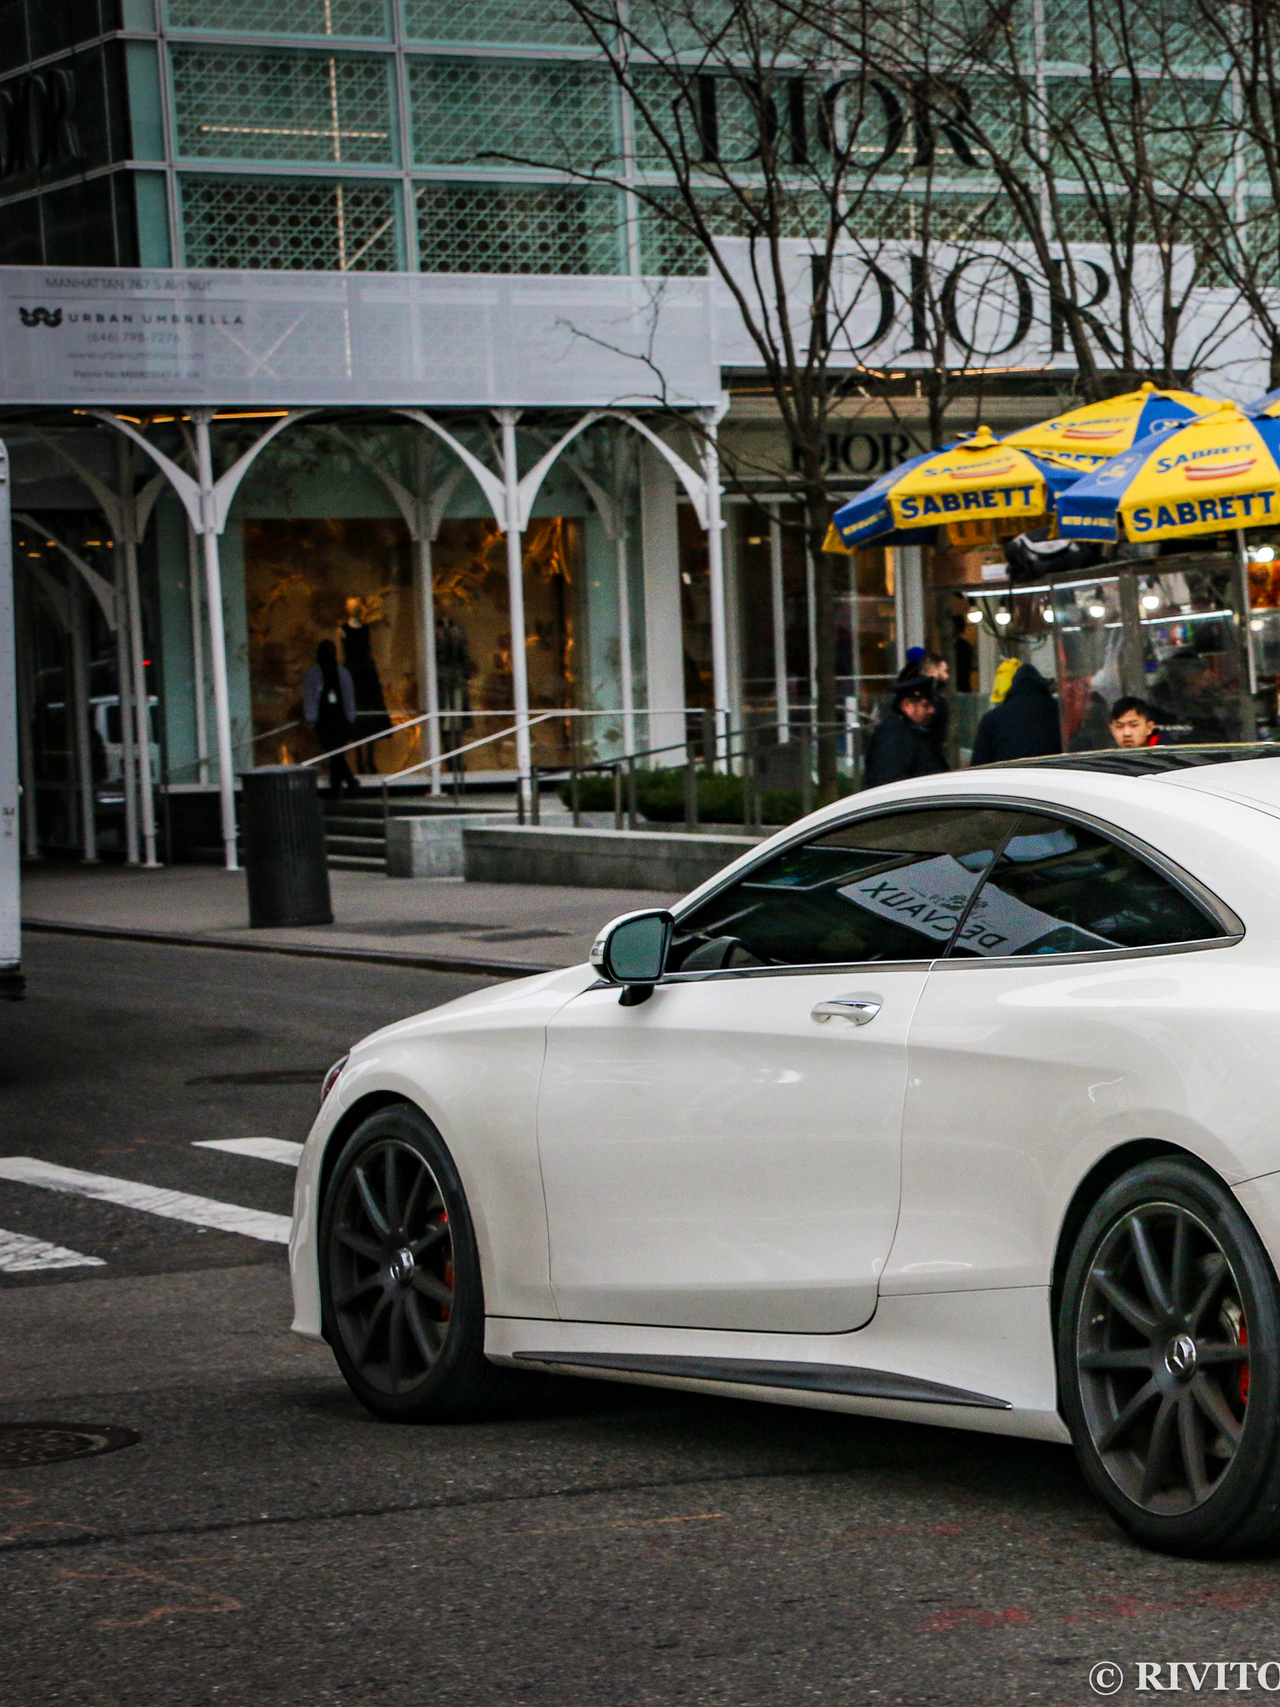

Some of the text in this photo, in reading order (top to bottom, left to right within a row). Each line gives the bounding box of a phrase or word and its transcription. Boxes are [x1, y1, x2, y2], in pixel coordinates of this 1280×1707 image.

[690, 74, 988, 168] DIOR
[45, 277, 125, 290] MANHATTAN
[68, 313, 244, 326] URBAN UMBRELLA
[798, 253, 1128, 355] DIOR
[1156, 443, 1254, 474] SABRETT
[900, 485, 1036, 520] SABRETT
[1132, 490, 1277, 533] SABRETT
